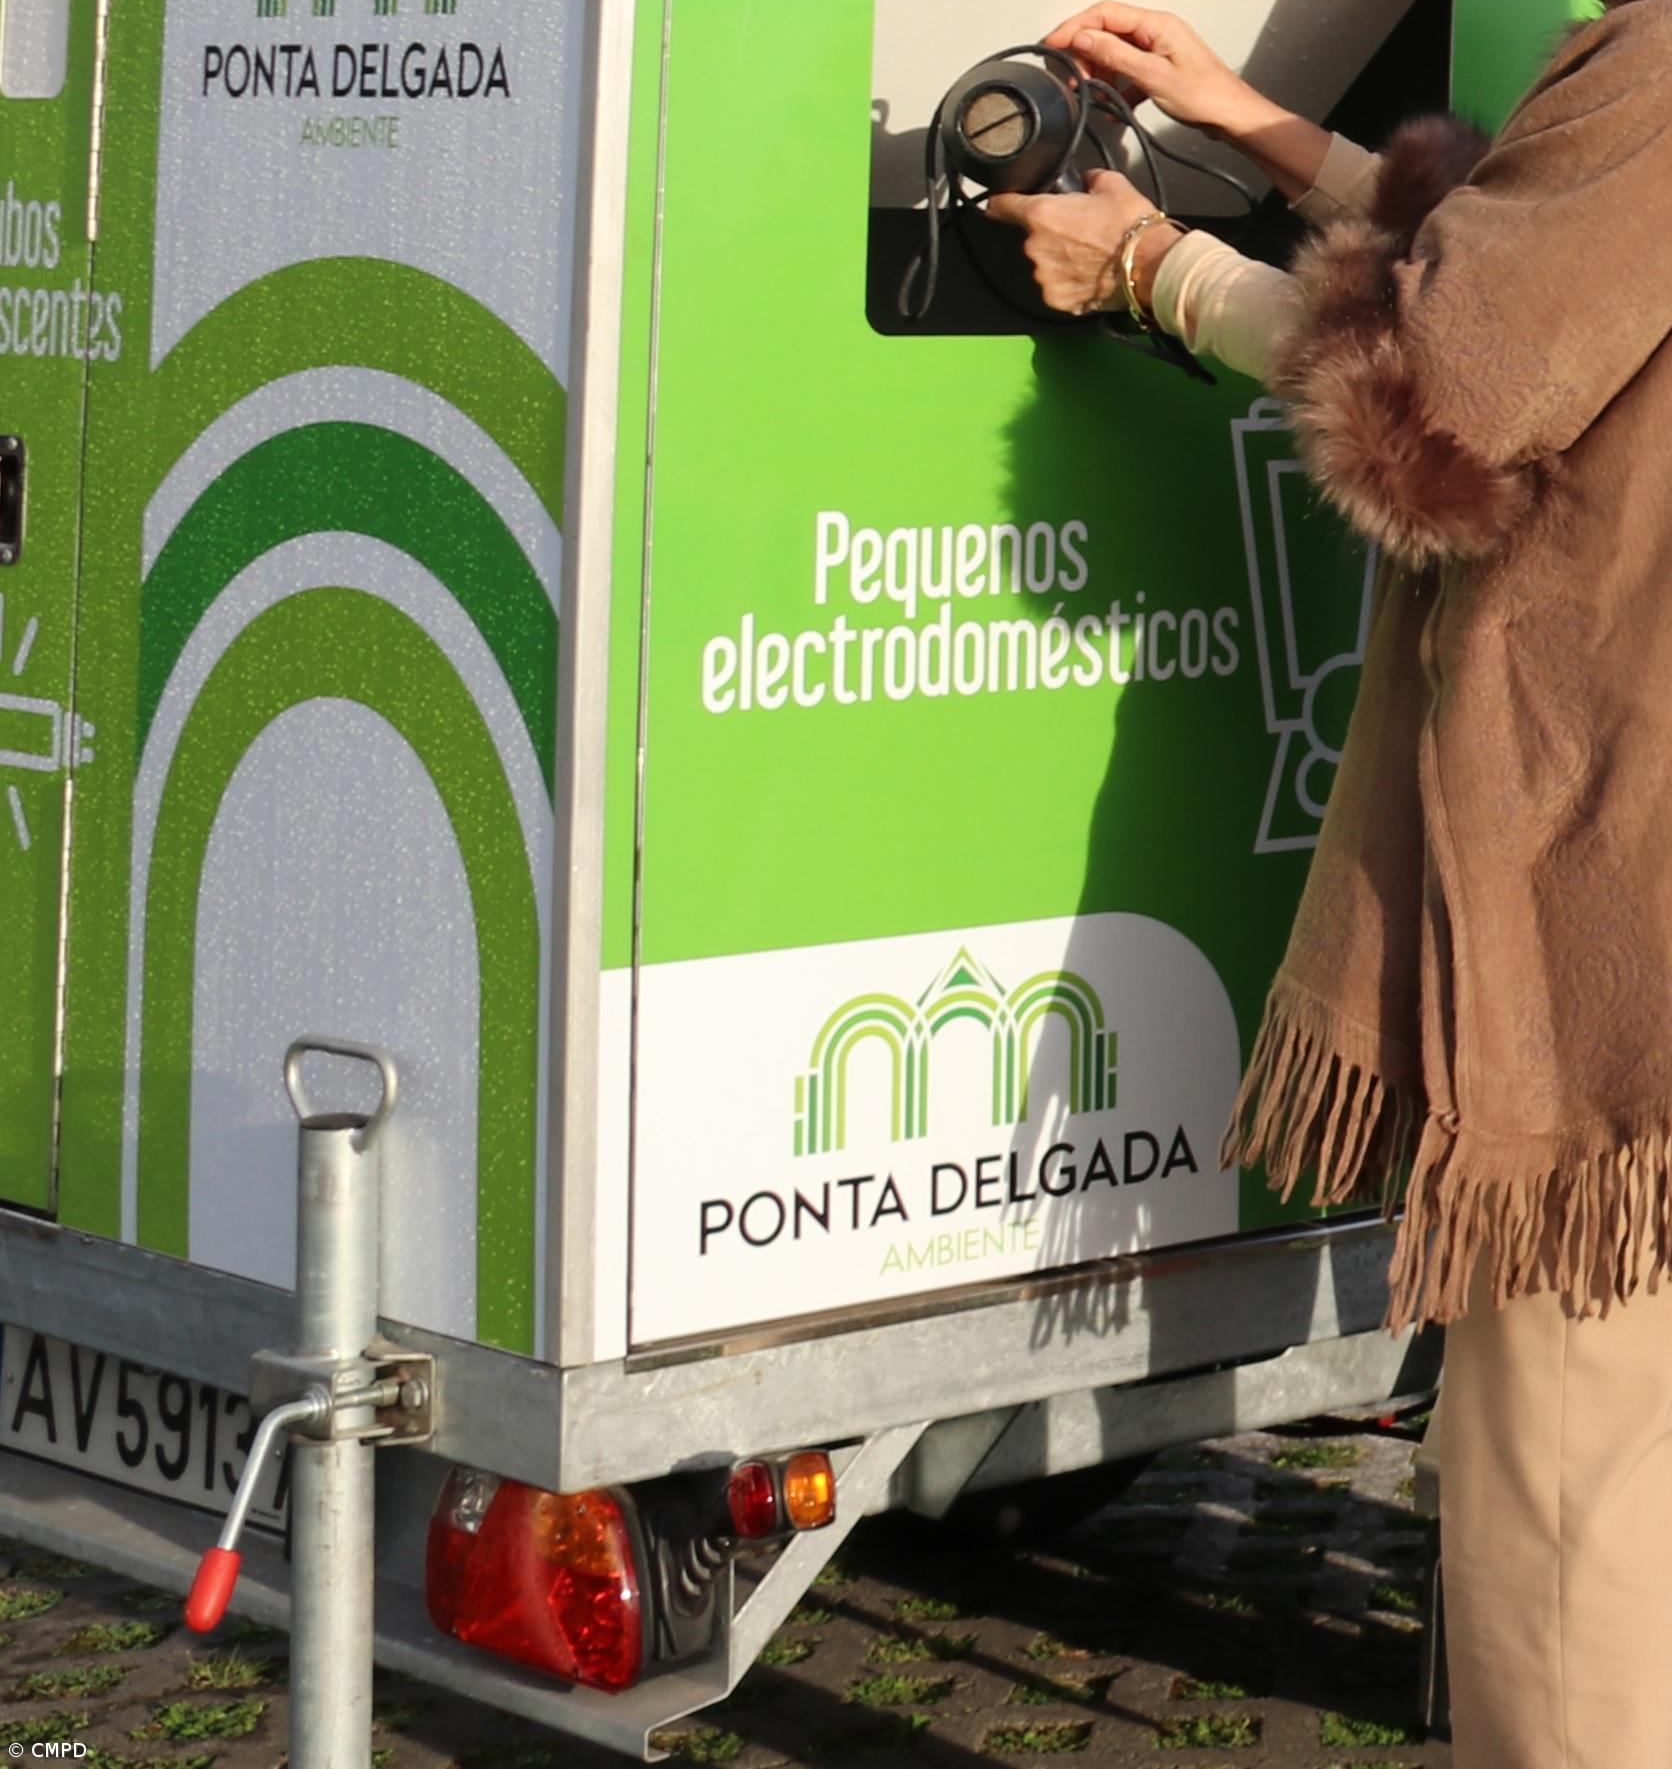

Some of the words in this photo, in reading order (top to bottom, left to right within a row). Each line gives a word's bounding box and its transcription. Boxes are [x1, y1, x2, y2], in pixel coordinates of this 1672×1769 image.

[202, 43, 320, 99] PONTA
[331, 42, 511, 99] DELGADA
[300, 115, 400, 149] AMBIENTE
[0, 180, 61, 269] bos
[813, 510, 1089, 618] Pequenos
[701, 592, 1240, 713] electrodomésticos
[700, 1172, 908, 1256] PONTA
[931, 1125, 1198, 1217] DELGADA
[879, 1218, 1040, 1276] AMBIENTE
